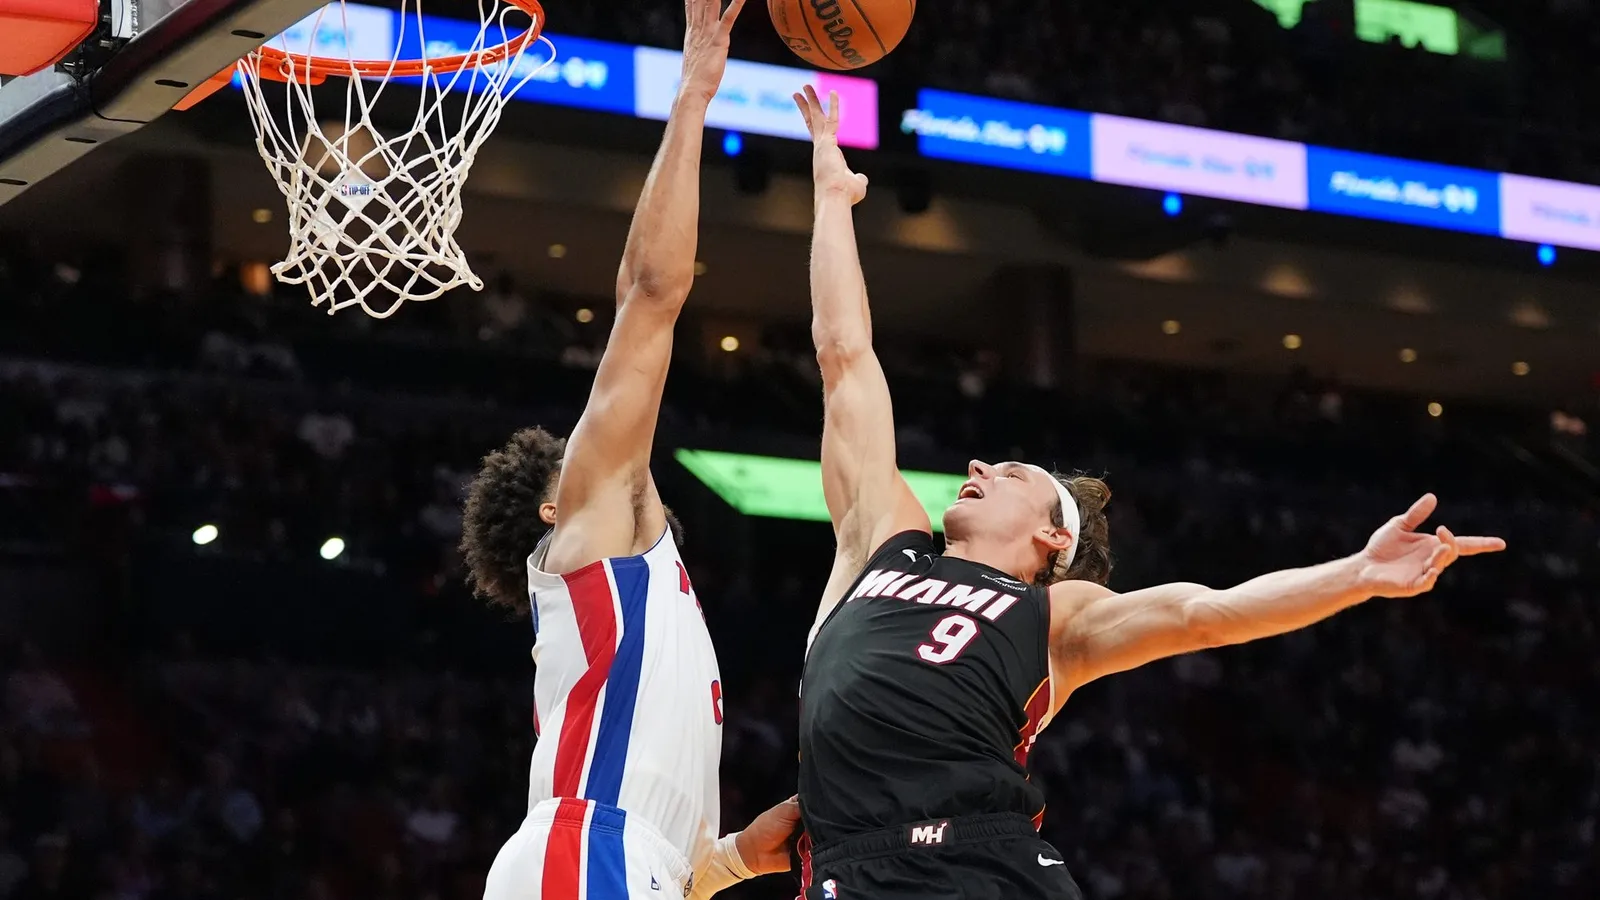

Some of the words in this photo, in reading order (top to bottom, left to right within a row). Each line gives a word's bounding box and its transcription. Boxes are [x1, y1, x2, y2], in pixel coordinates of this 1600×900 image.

[810, 0, 866, 65] Wilson
[846, 569, 1020, 622] MIAMI
[915, 613, 981, 665] 9
